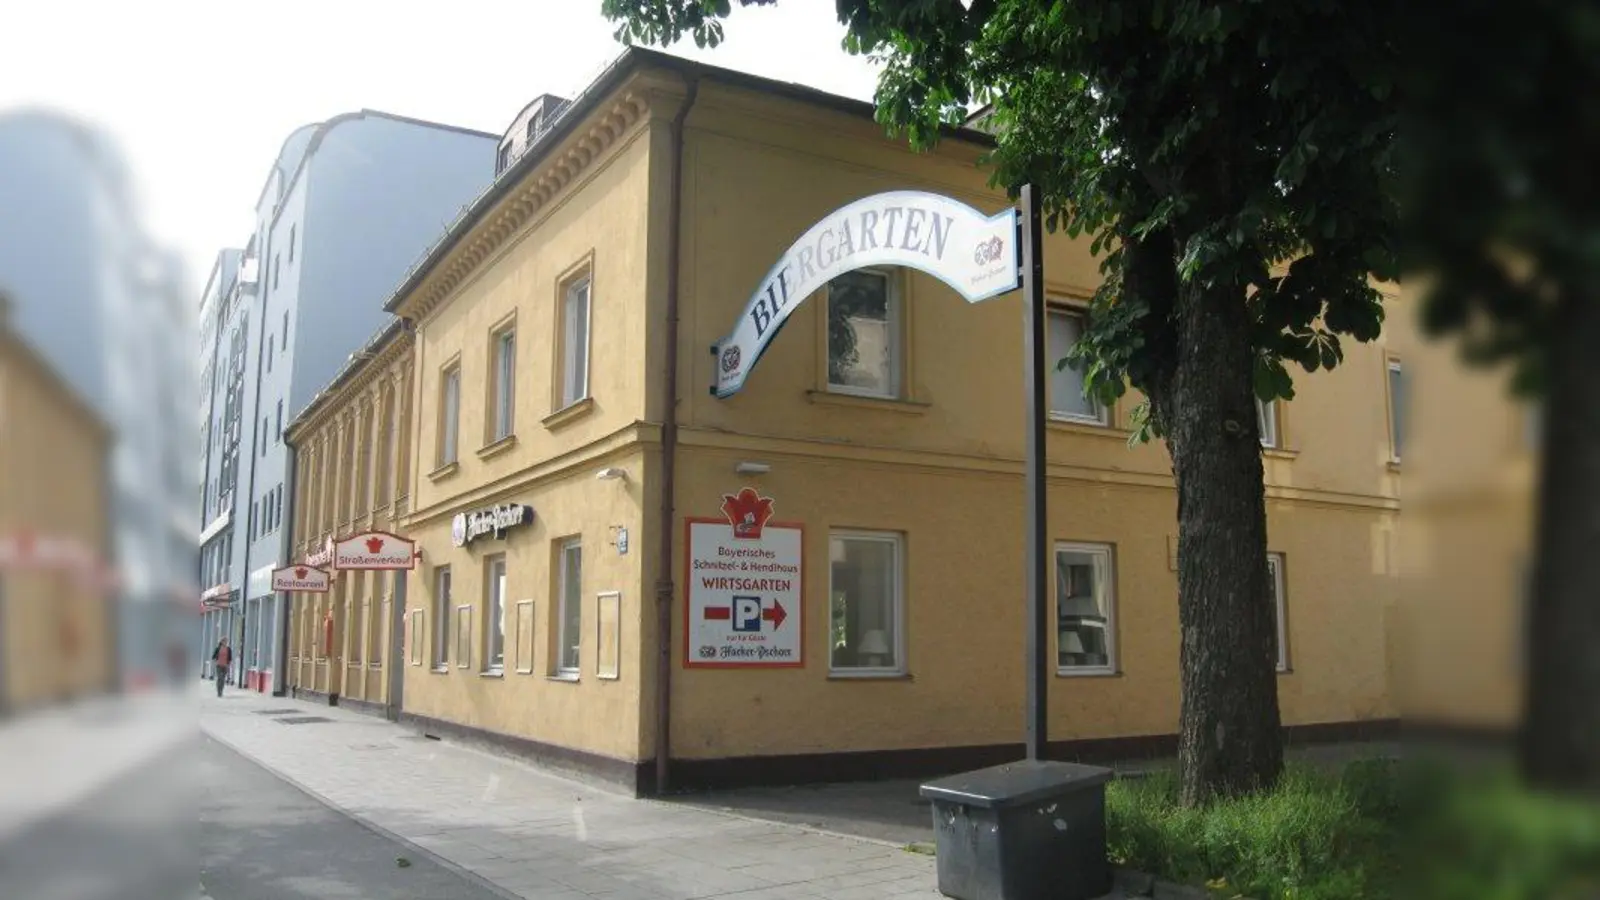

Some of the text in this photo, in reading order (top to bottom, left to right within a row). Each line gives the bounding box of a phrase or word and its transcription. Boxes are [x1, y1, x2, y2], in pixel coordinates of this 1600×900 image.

[750, 206, 954, 340] BIERGARTEN
[718, 546, 776, 559] Bayerisches
[339, 555, 410, 565] Straßenverkauf
[693, 559, 798, 573] Schnitzel- & Hendlhaus
[277, 578, 324, 588] Restaurant
[702, 577, 790, 592] WIRTSGARTEN
[736, 598, 760, 630] P
